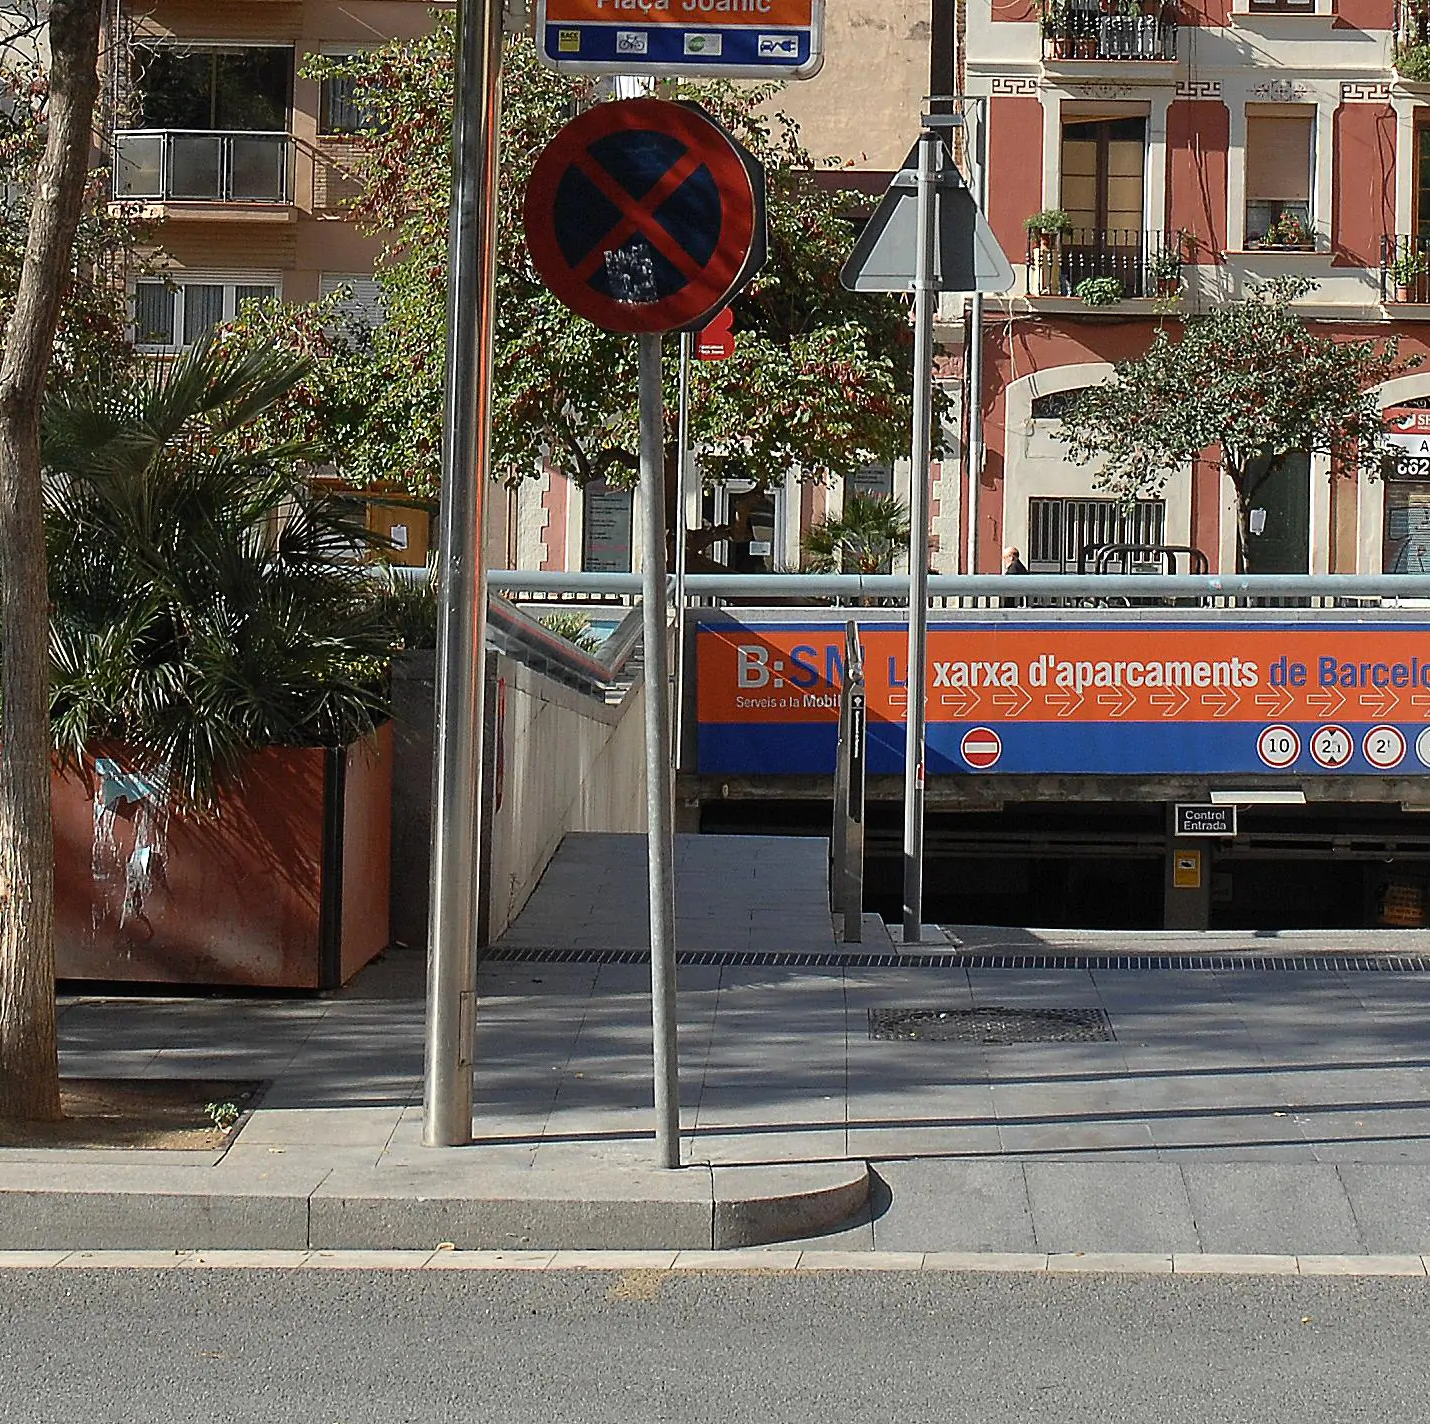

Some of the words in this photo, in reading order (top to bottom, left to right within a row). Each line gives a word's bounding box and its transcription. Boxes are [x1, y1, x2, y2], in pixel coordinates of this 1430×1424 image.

[932, 660, 1019, 687] xarxa
[1028, 654, 1260, 694] d'aparcaments
[1269, 655, 1307, 687] de
[735, 695, 777, 708] Serveis
[779, 697, 787, 708] a
[789, 696, 800, 708] la
[803, 694, 841, 708] Mobil
[1269, 738, 1290, 753] 10
[1185, 810, 1225, 820] Control
[1183, 820, 1227, 831] Entrada
